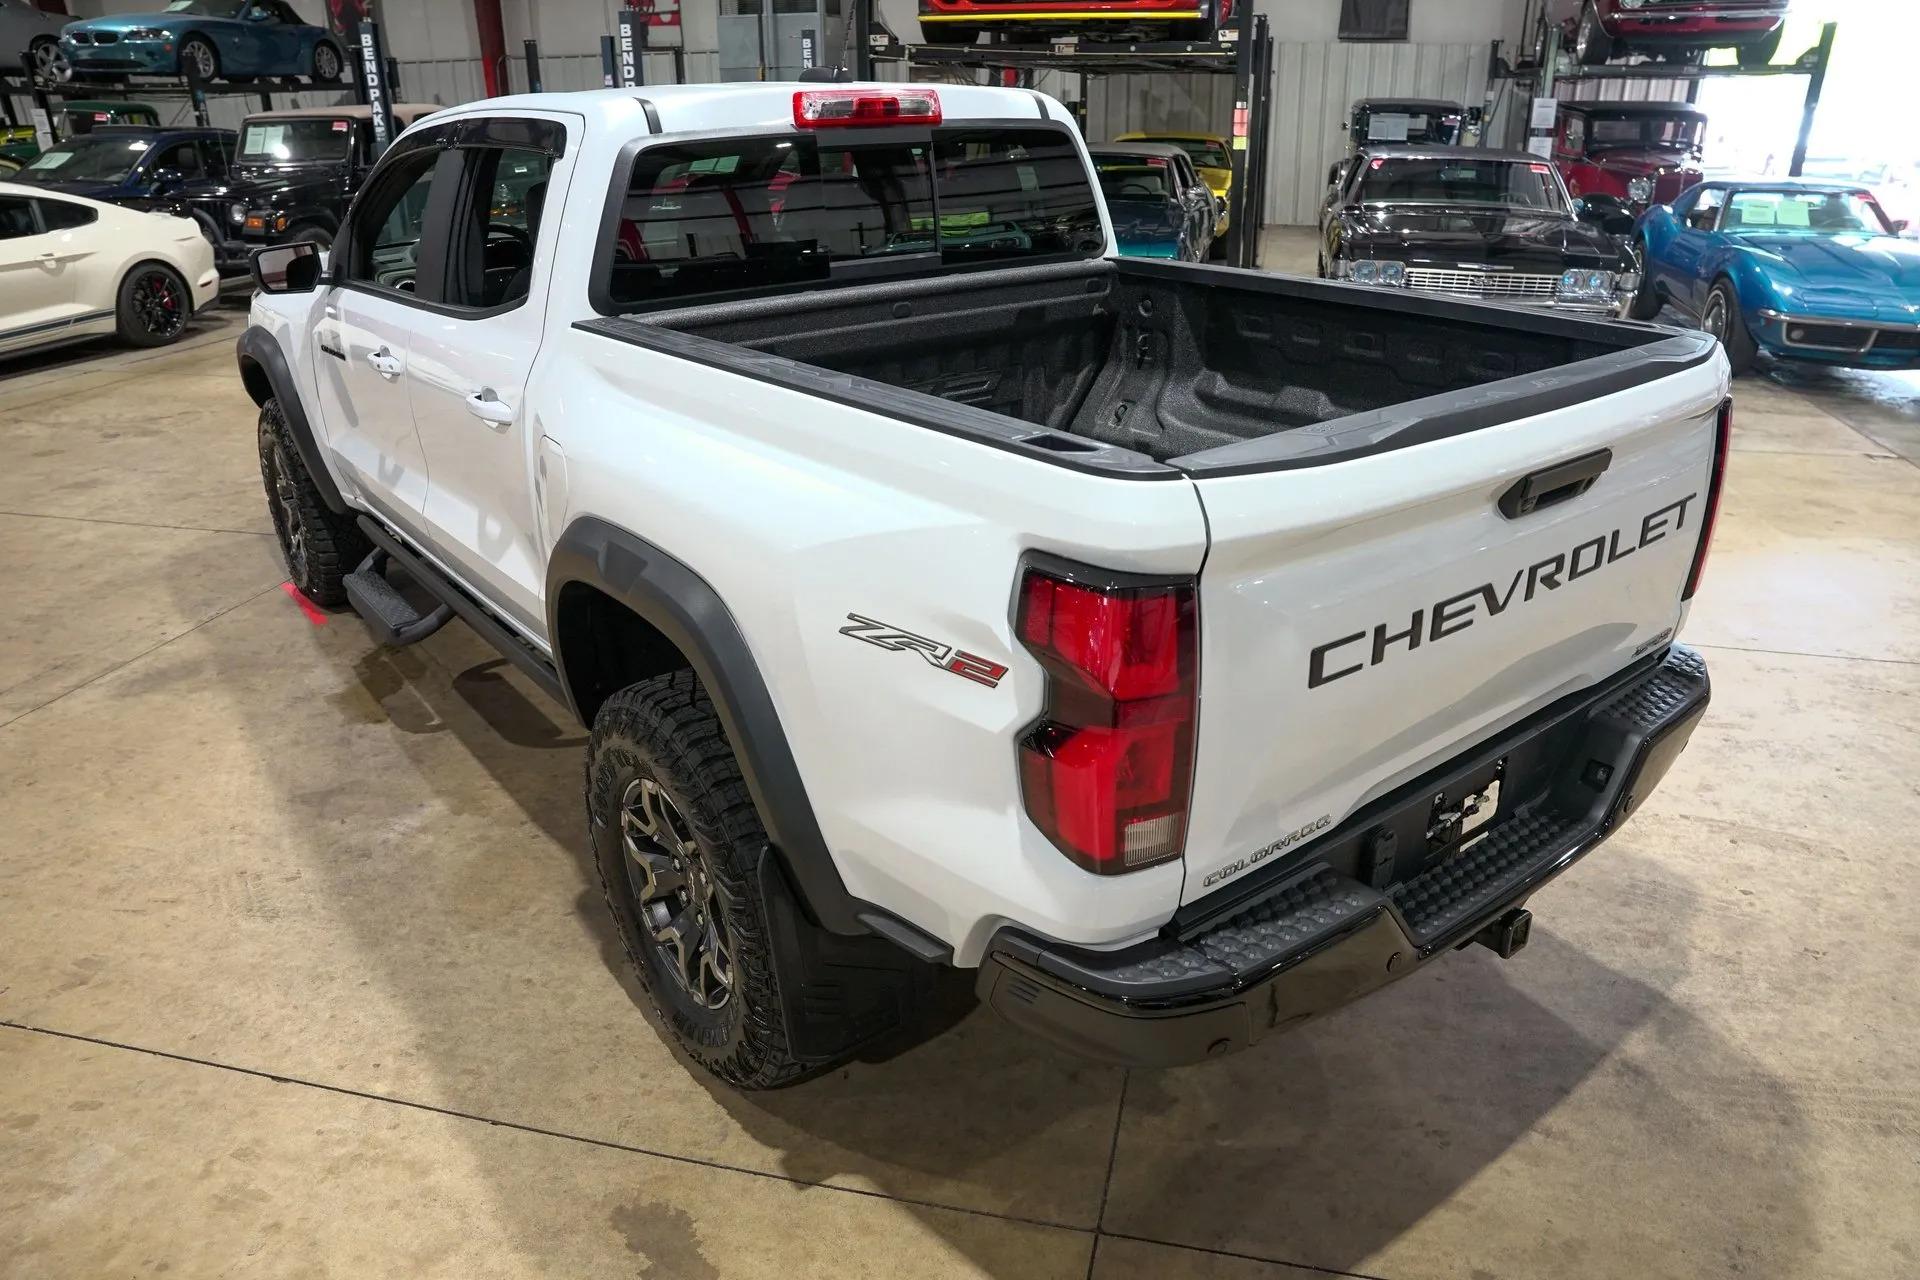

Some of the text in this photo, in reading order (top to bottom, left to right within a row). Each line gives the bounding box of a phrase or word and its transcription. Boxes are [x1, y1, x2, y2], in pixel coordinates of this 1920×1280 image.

[360, 33, 385, 127] BENDPAK
[1308, 492, 1698, 689] CHEVROLET
[838, 612, 1009, 688] ZR2
[1202, 813, 1332, 887] COLORADO
